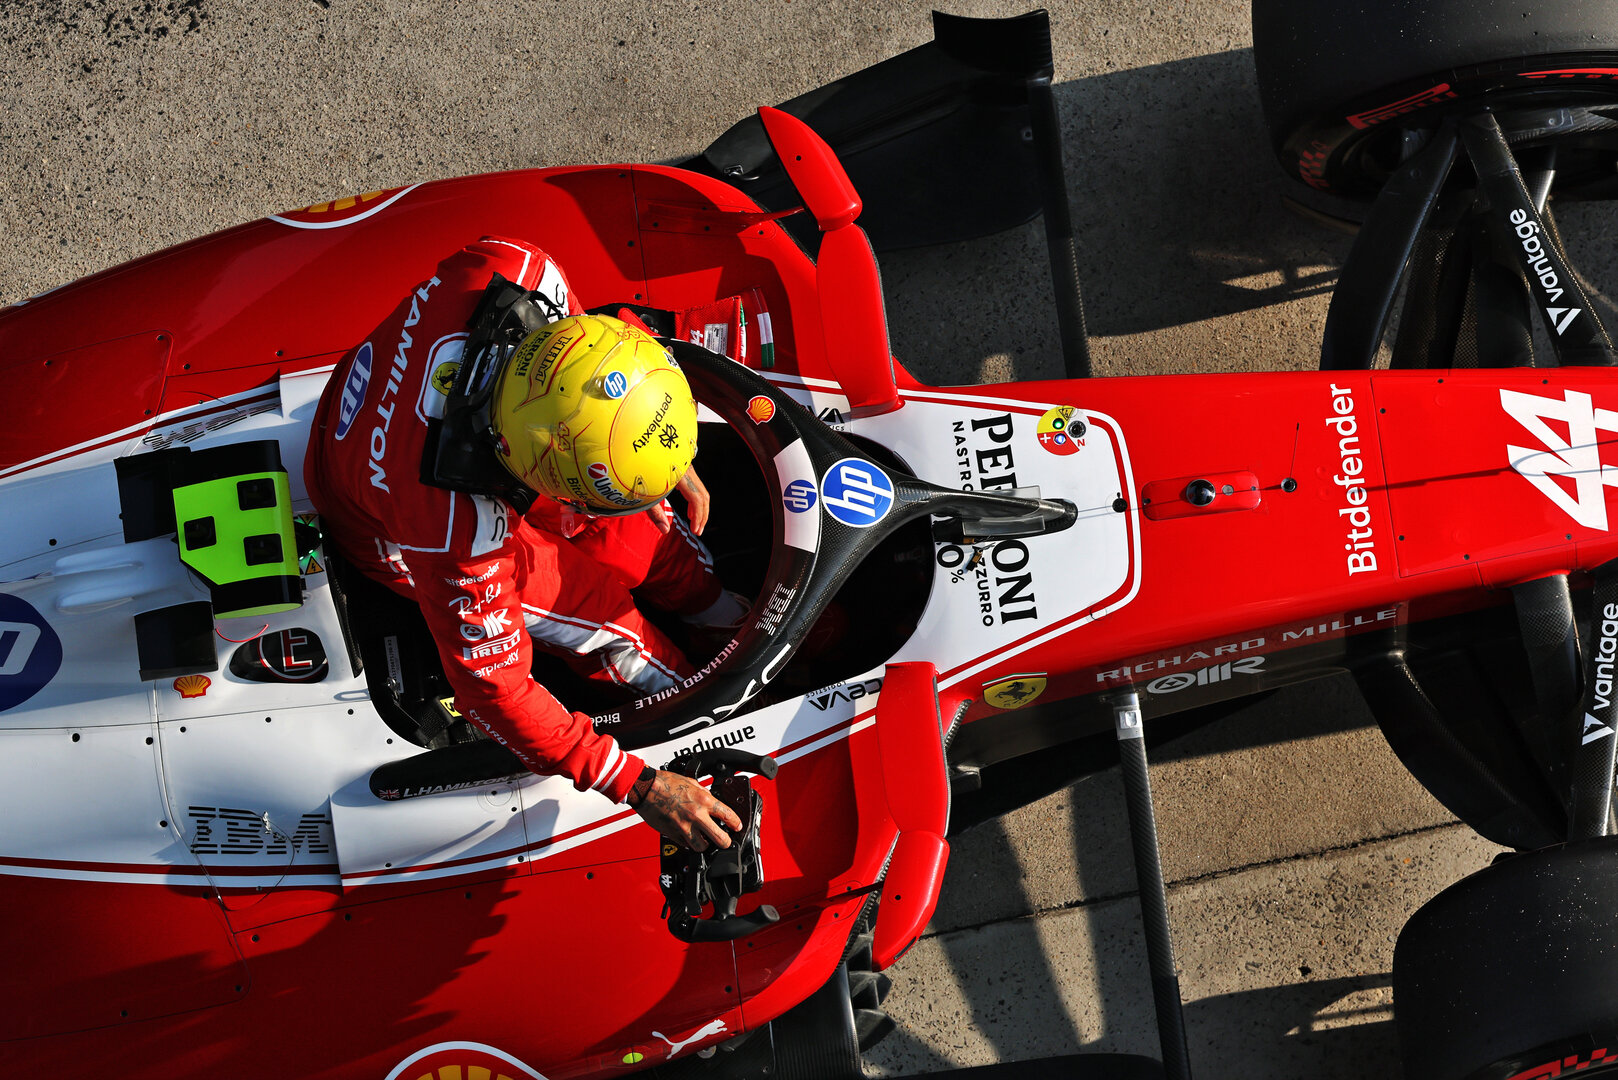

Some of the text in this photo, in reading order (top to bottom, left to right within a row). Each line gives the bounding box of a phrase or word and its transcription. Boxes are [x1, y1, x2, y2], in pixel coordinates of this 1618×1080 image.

[1509, 207, 1565, 303] vantage
[517, 331, 553, 377] PERONI
[368, 275, 442, 495] HAMILTON
[605, 373, 625, 397] hp
[632, 392, 673, 453] perplexity
[1326, 383, 1378, 576] Bitdefender
[1499, 388, 1618, 532] 44
[783, 484, 817, 509] hp
[822, 465, 892, 518] hp
[444, 562, 500, 587] Bitdefender
[755, 583, 797, 636] IBM
[462, 629, 521, 661] PIRELLI
[1096, 608, 1397, 683] RICHARD MILLE
[1593, 602, 1618, 711] vantage
[635, 639, 740, 710] RICHARD MILLE
[805, 681, 847, 698] LOGISTICS
[403, 774, 510, 799] L.HAMILTON
[188, 805, 330, 855] IBM
[661, 873, 673, 889] 44
